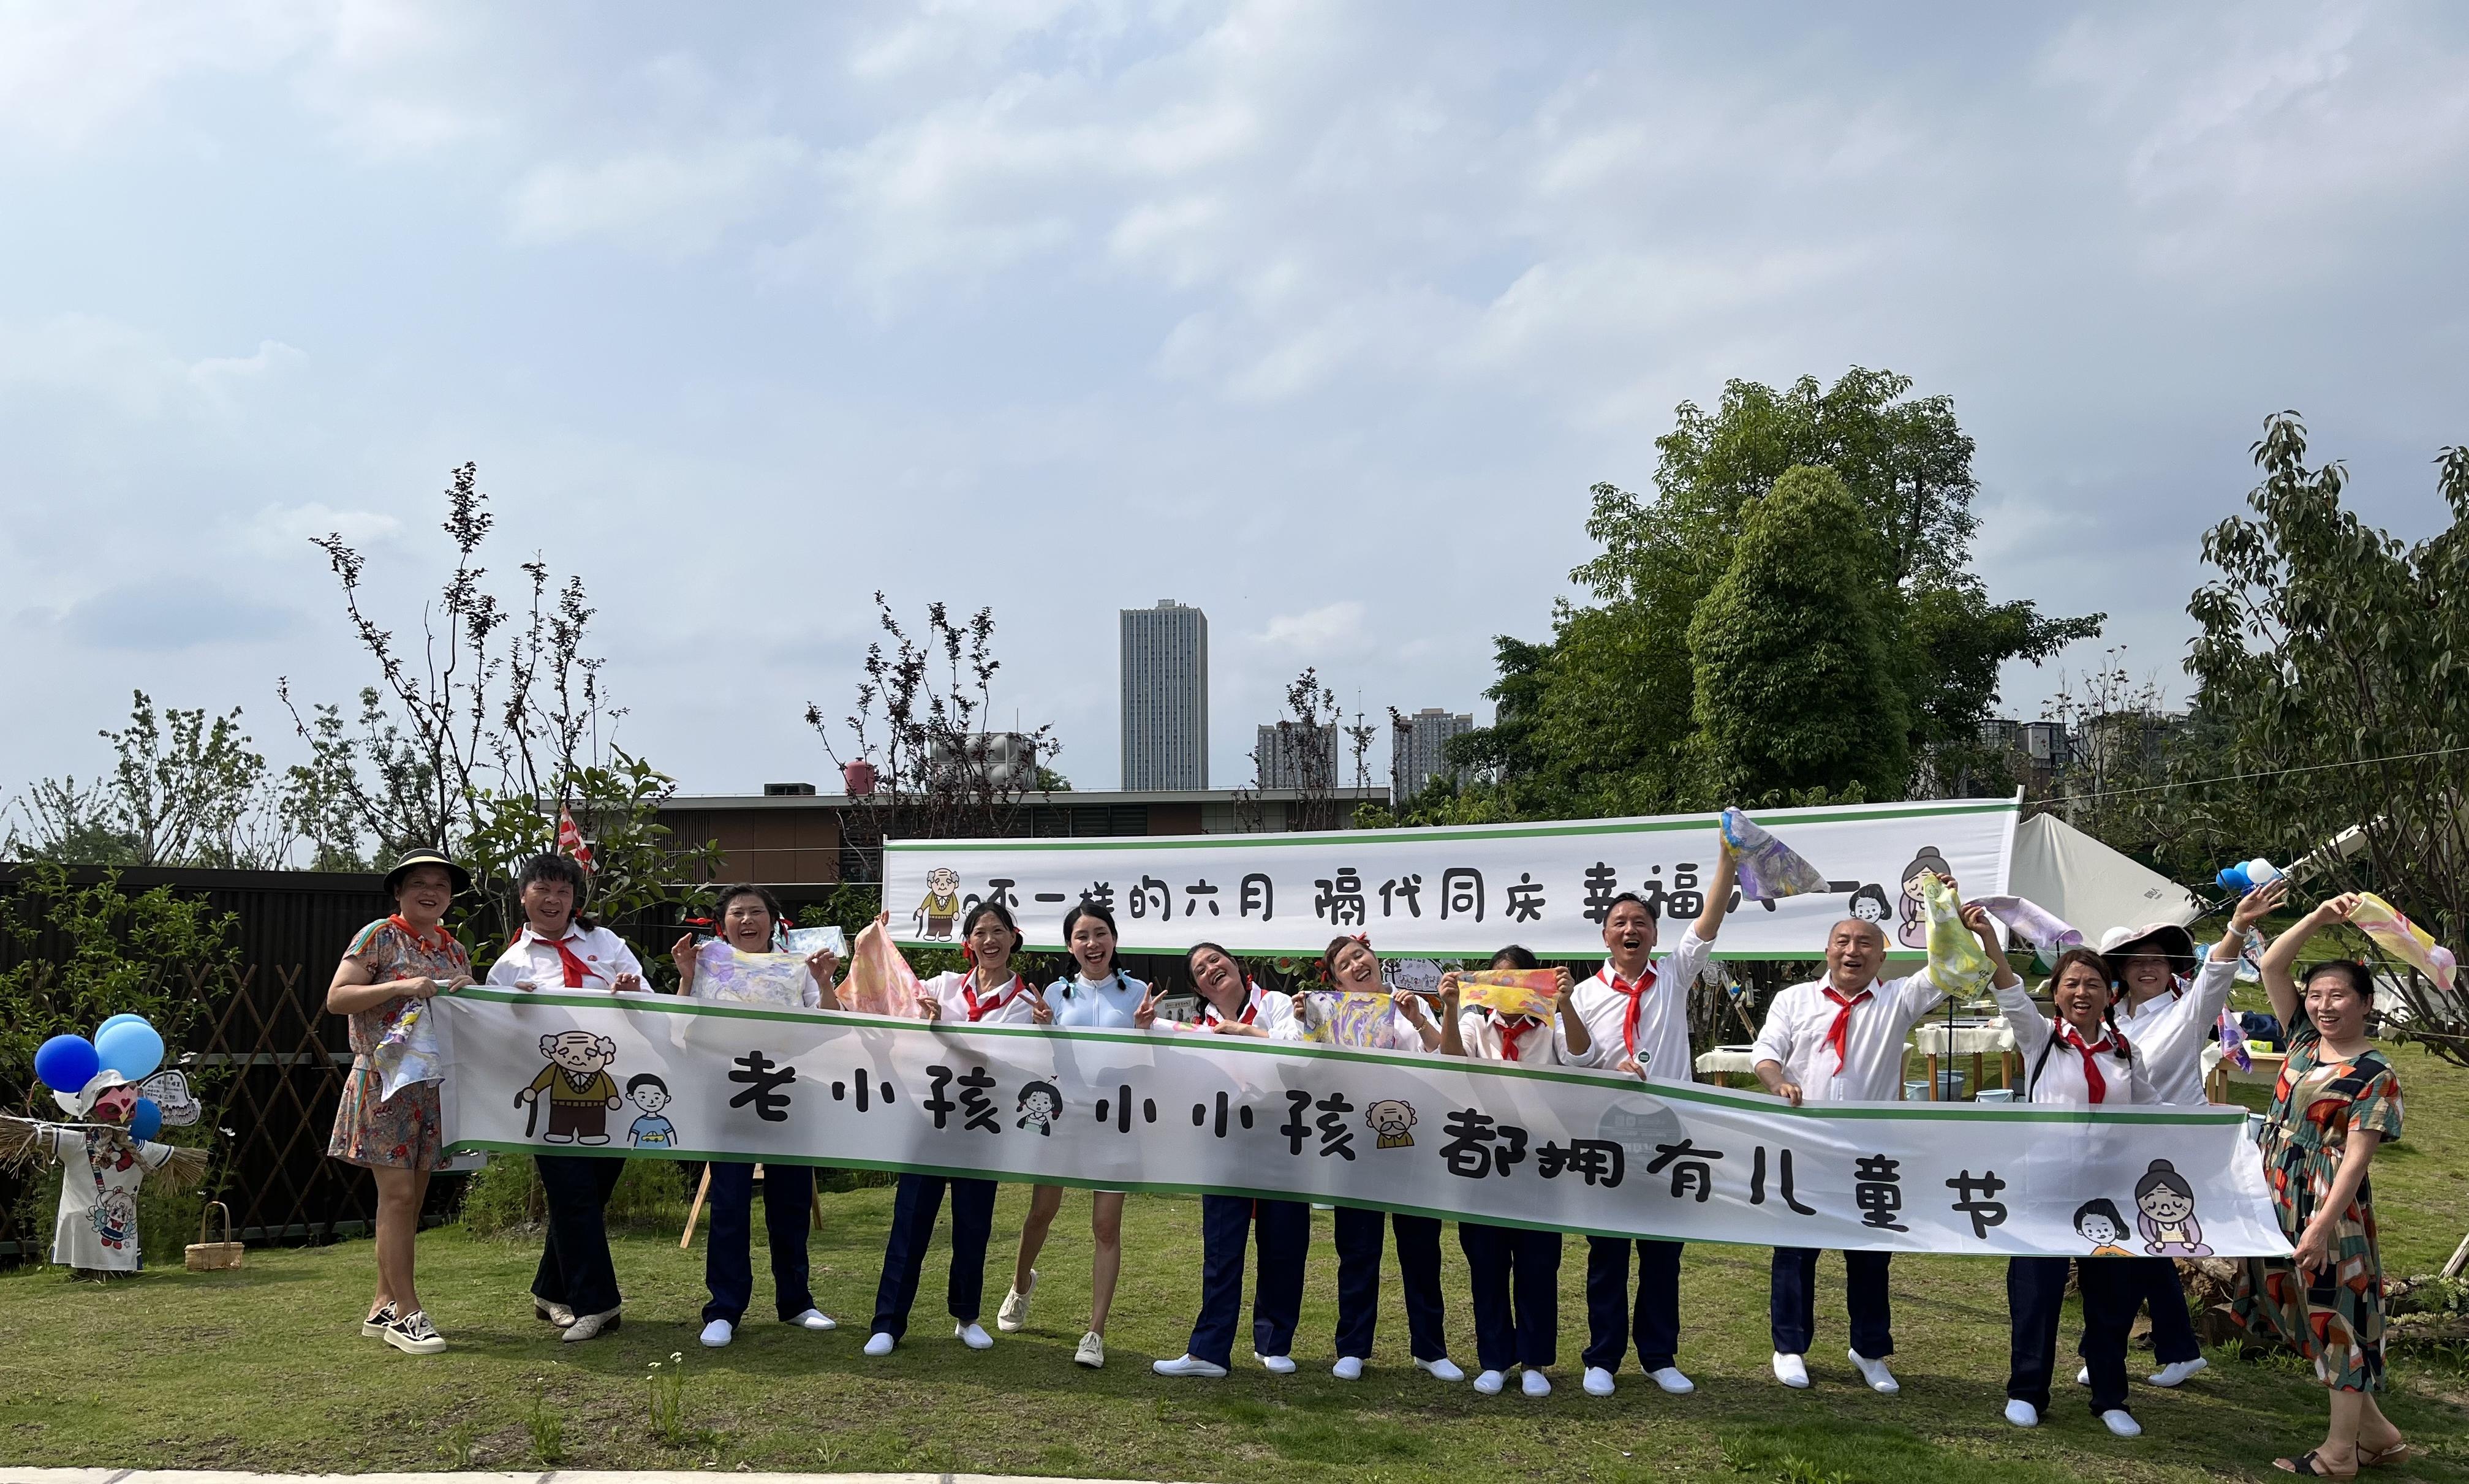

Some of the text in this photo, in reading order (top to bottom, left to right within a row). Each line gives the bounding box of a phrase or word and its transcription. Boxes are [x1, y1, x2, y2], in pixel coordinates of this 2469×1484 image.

[1314, 867, 1546, 927] 隔代同庆
[727, 1050, 2008, 1240] 老小孩 小小孩 都拥有儿童节
